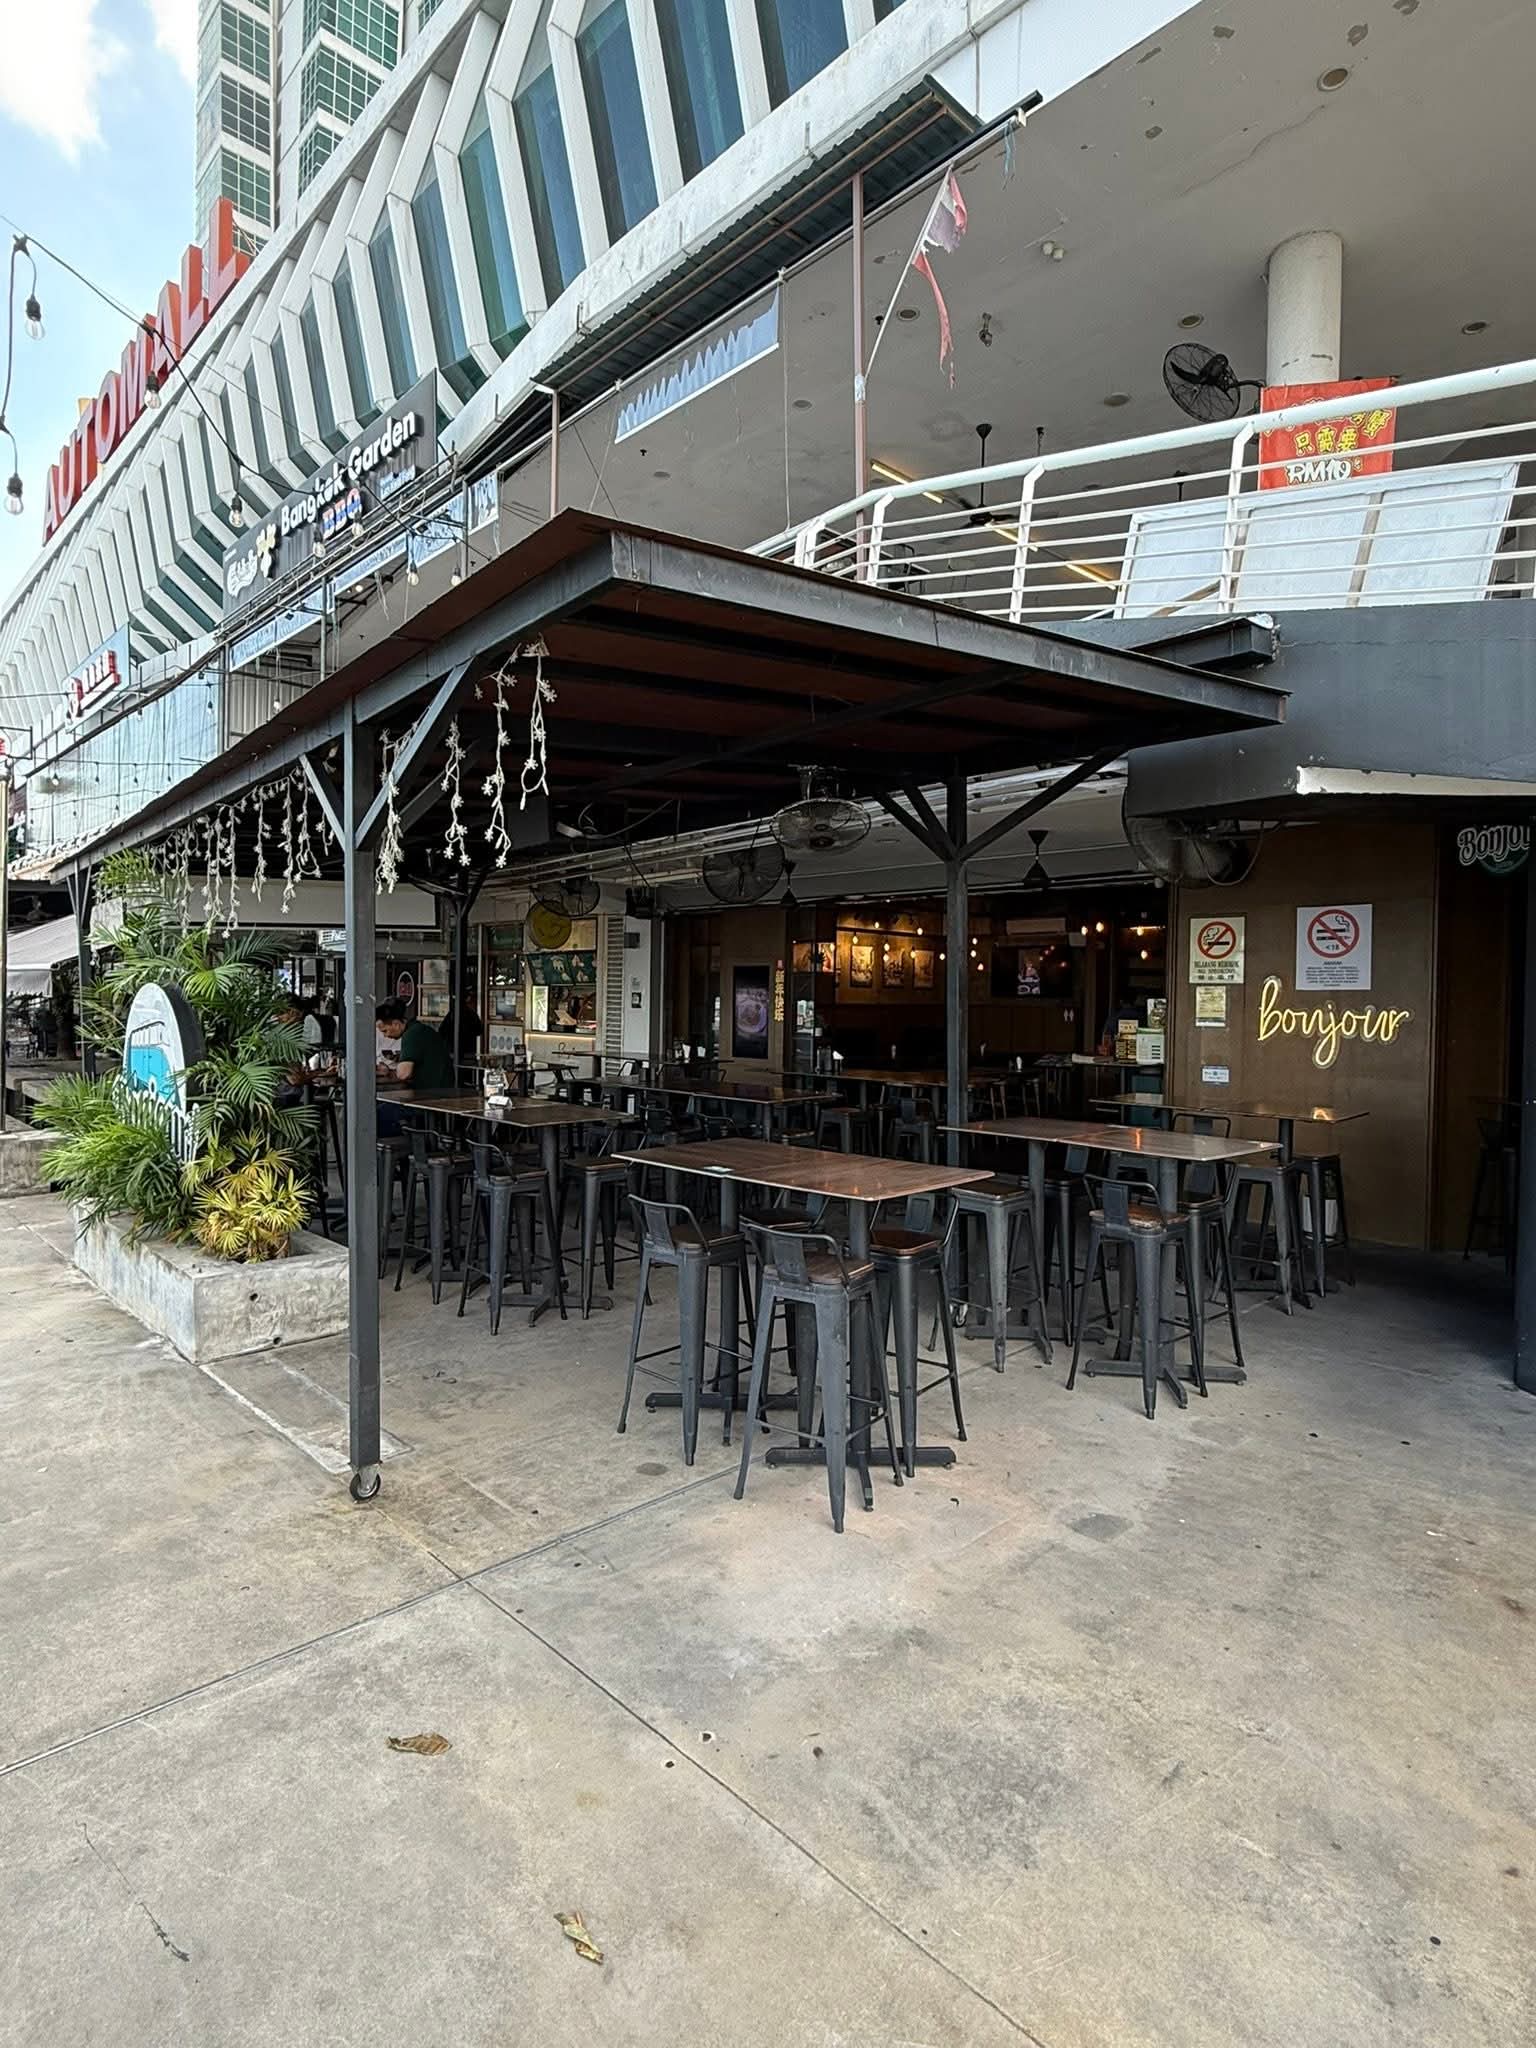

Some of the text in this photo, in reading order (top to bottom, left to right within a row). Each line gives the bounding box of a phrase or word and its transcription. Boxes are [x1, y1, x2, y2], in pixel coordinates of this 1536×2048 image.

[43, 196, 250, 547] AUTOMALL
[281, 461, 345, 537] Bangkok
[348, 411, 417, 481] Garden
[1258, 975, 1410, 1068] bonjour
